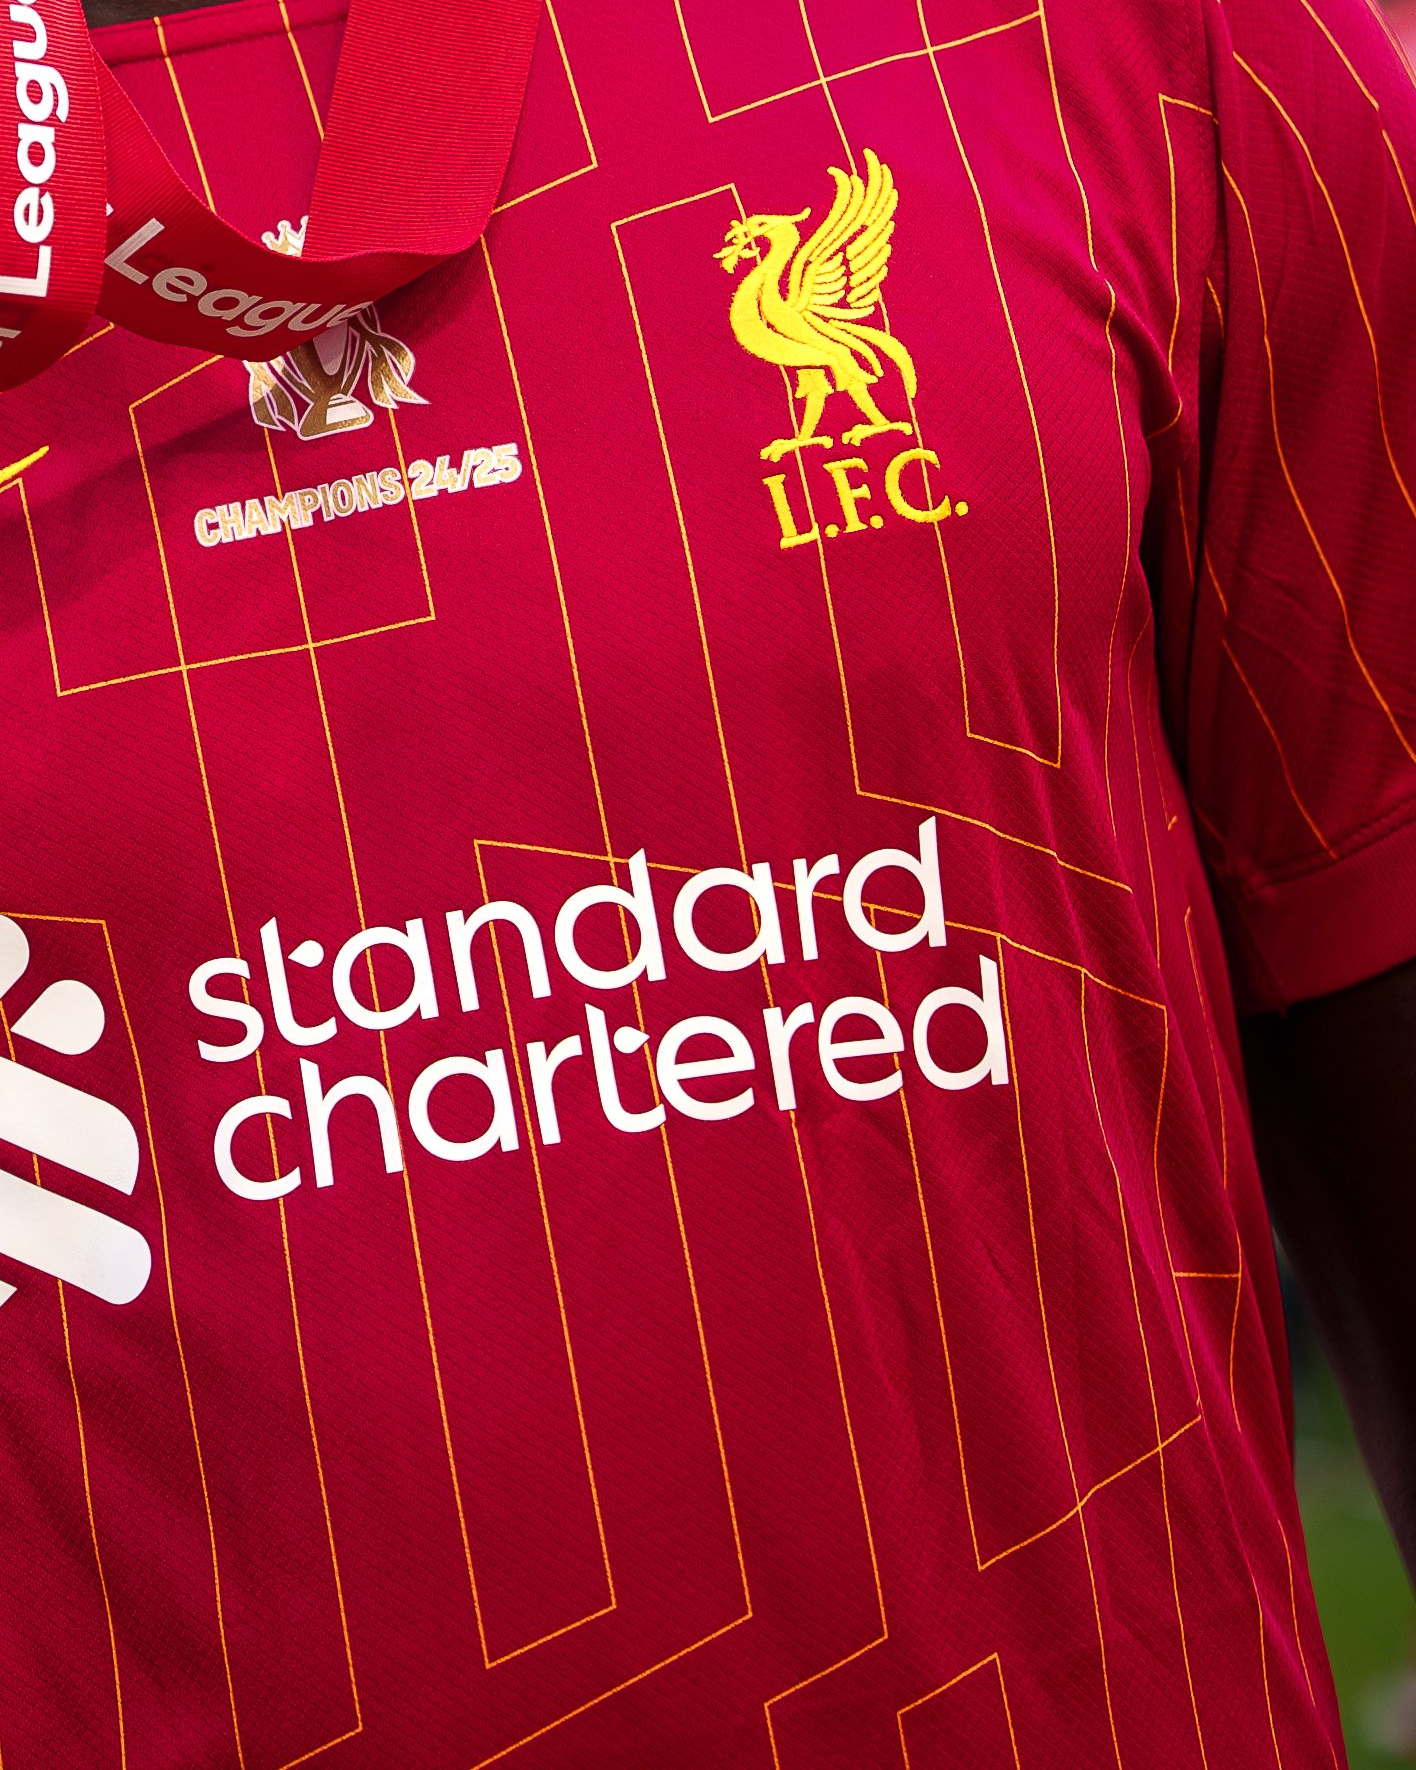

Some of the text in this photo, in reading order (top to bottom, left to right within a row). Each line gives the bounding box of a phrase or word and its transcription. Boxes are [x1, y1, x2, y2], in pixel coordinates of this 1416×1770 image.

[194, 442, 522, 547] CHAMPIONS 24/25
[762, 447, 969, 549] L.F.C.
[188, 815, 948, 1063] standard
[213, 954, 1010, 1201] chartered
